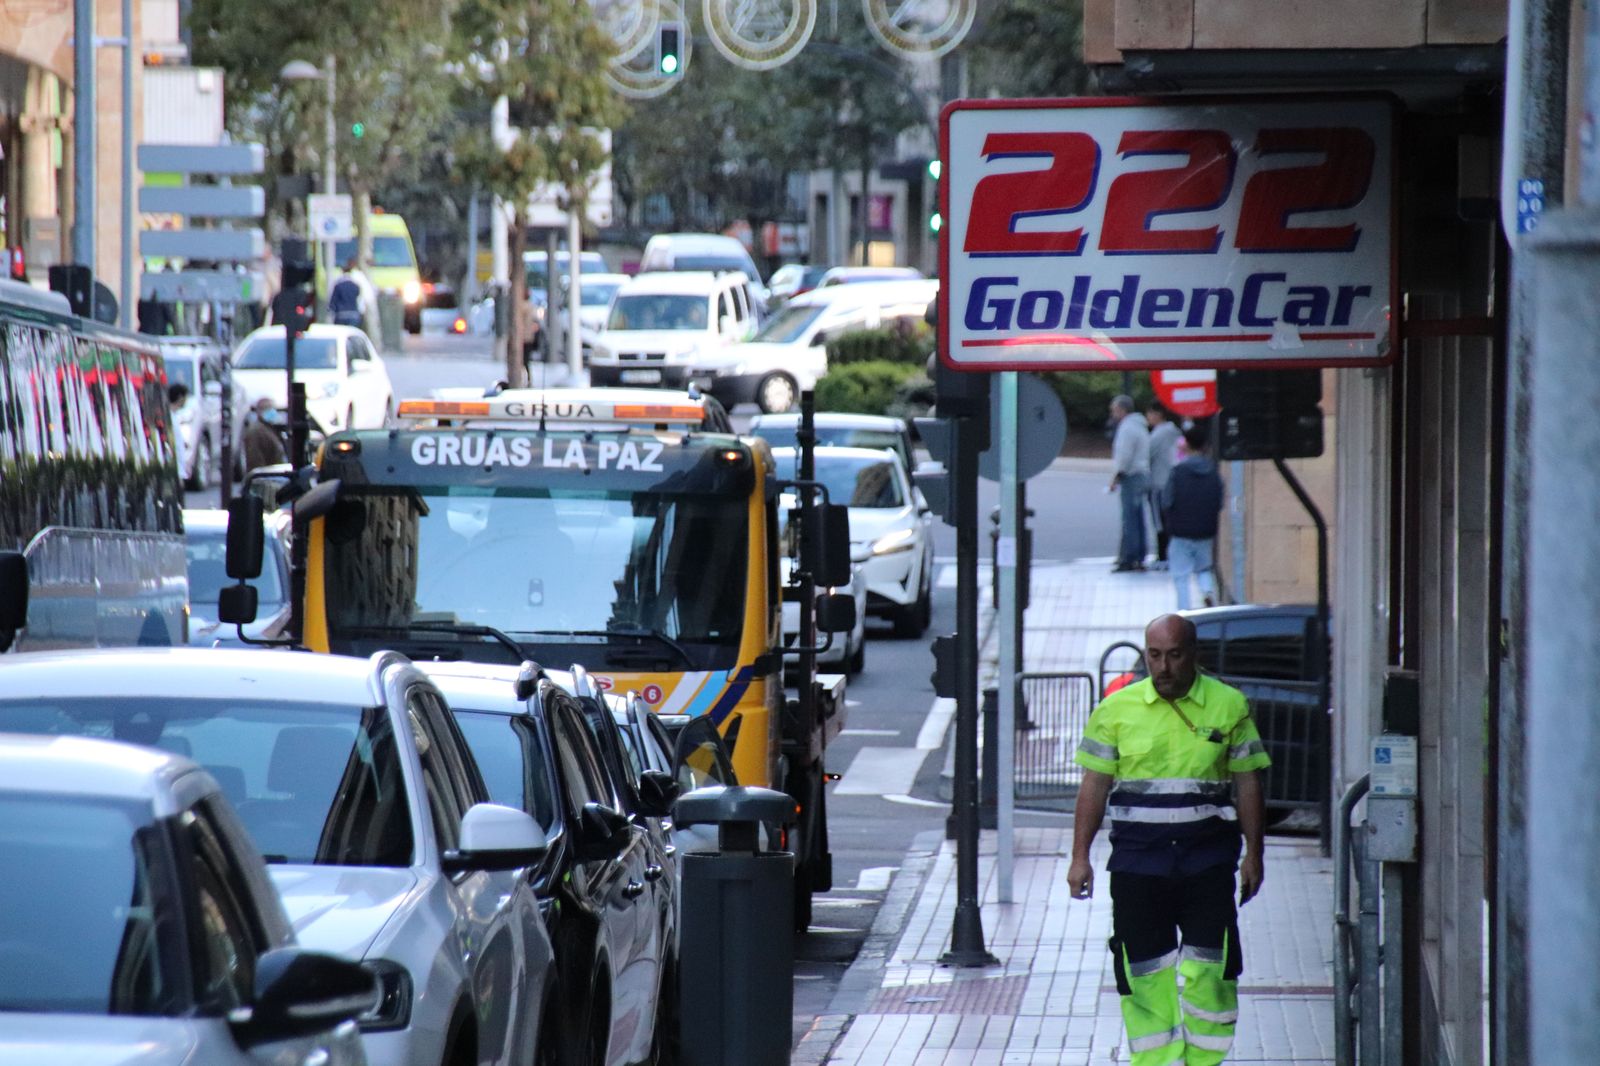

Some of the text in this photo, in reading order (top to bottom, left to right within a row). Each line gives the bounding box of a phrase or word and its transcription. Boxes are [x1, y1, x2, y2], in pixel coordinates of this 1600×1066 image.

[963, 127, 1375, 258] 222
[964, 272, 1372, 331] GoldenCar
[504, 402, 595, 418] GRUA
[410, 435, 664, 473] GRUAS LA PAZ
[648, 689, 657, 700] 6
